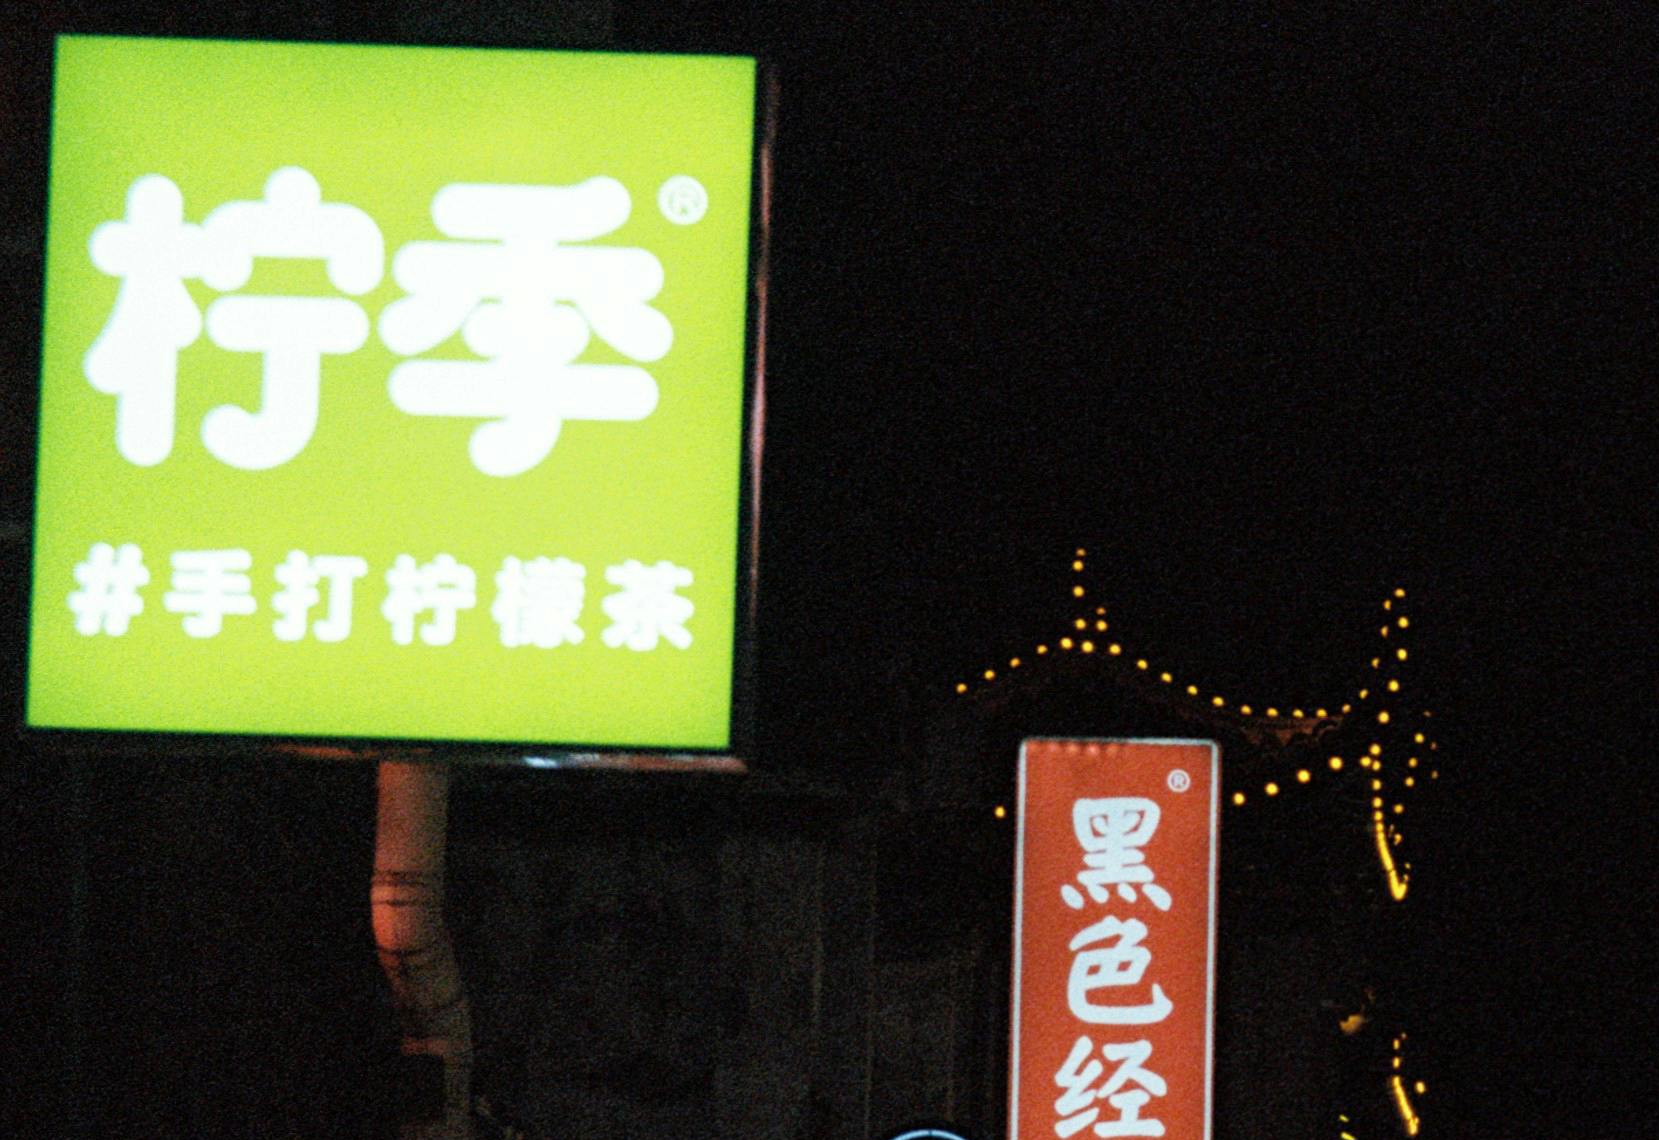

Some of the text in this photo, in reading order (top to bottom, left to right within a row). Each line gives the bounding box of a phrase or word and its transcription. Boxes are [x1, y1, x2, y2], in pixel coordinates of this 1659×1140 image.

[83, 165, 673, 477] 柠季
[66, 542, 695, 652] #手打柠檬茶
